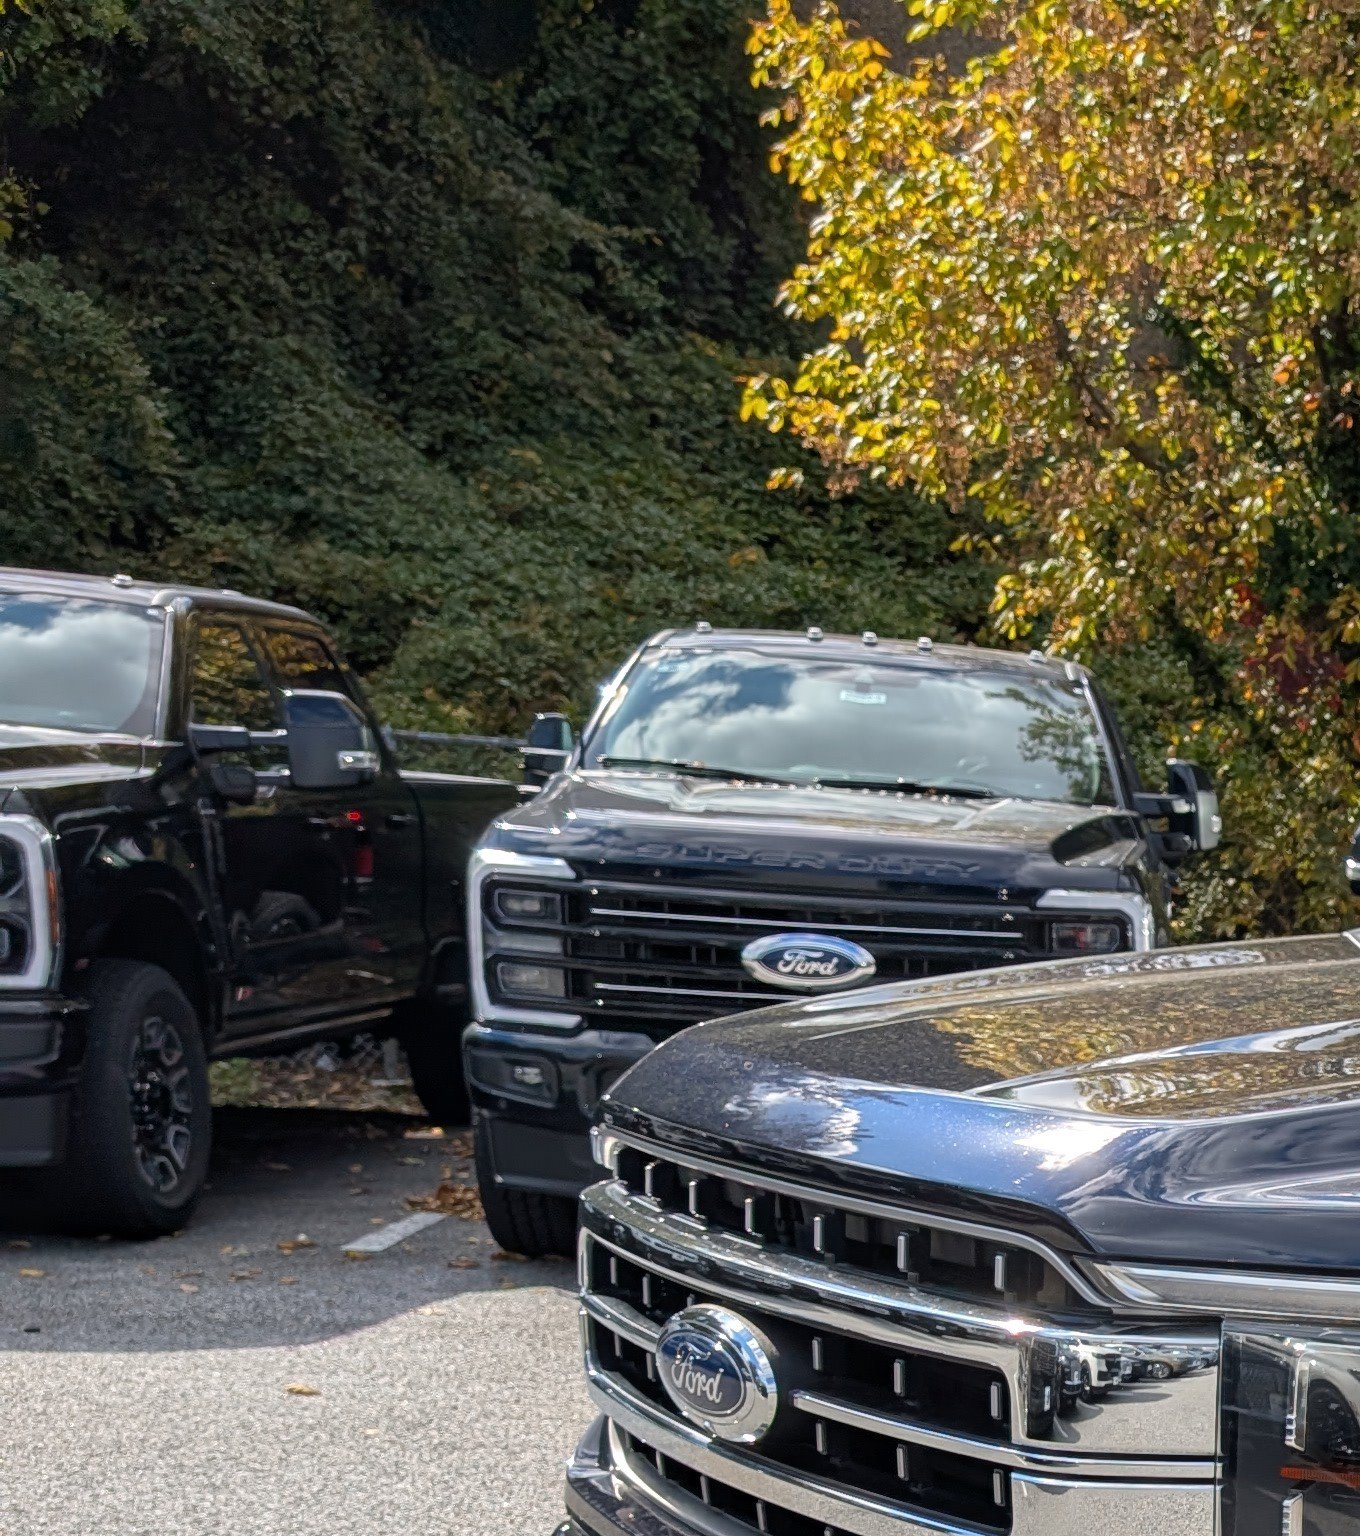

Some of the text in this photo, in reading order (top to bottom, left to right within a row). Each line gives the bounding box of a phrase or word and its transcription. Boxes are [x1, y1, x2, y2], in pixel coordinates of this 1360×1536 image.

[635, 842, 982, 879] SUPER DUTY
[777, 949, 840, 976] Ford
[670, 1341, 725, 1404] Ford
